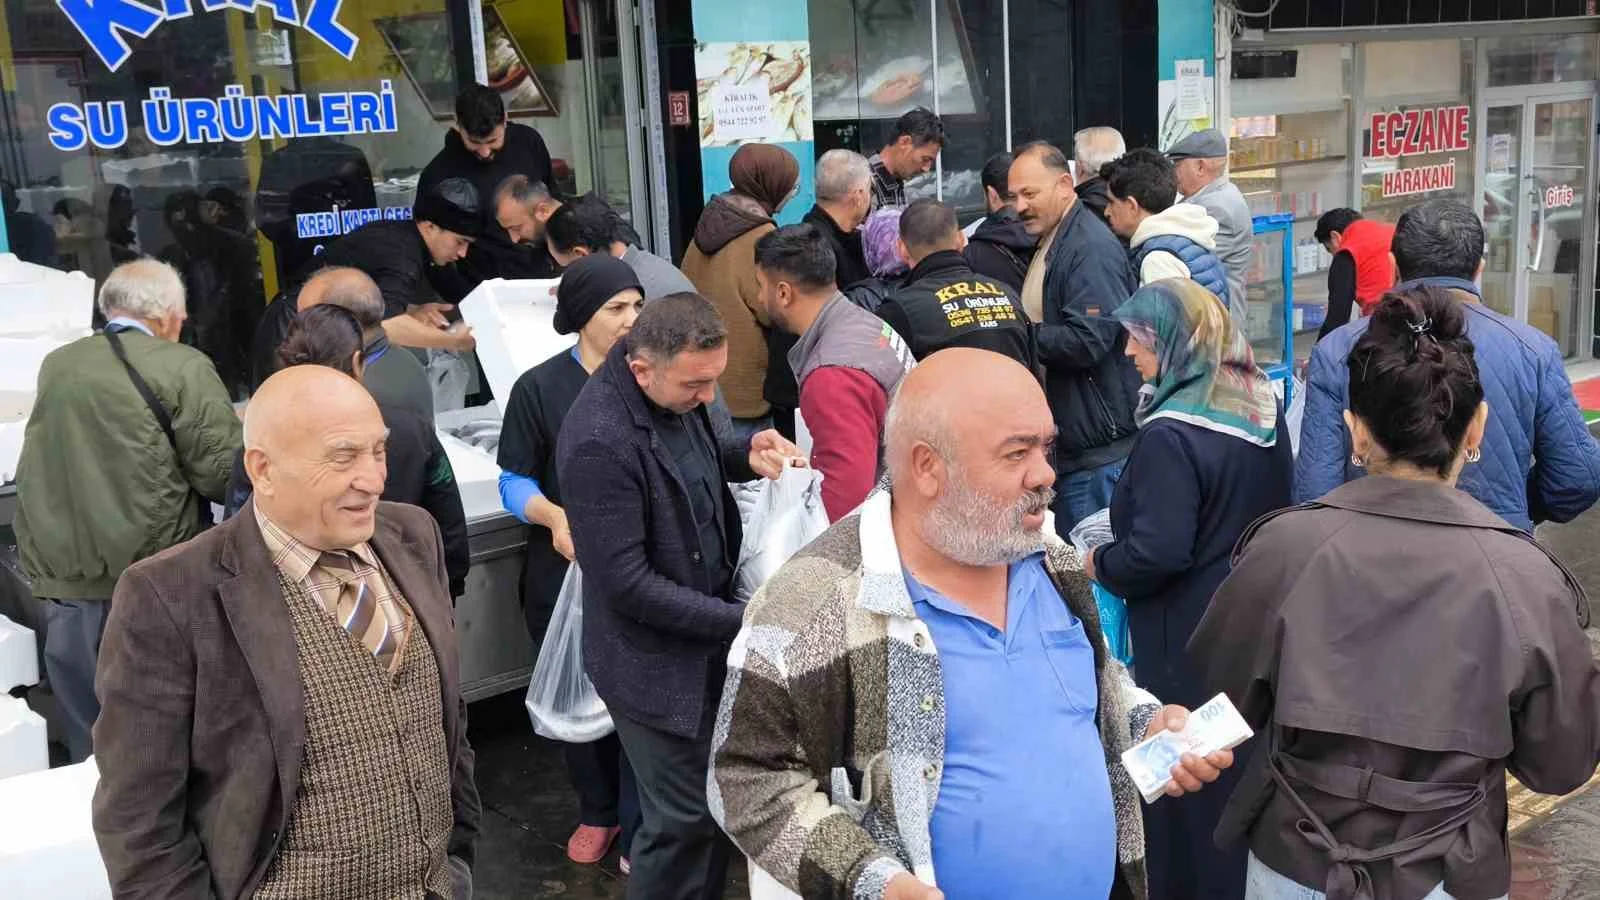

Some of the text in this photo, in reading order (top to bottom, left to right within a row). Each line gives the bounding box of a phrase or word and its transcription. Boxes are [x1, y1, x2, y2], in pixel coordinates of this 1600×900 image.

[47, 80, 398, 151] SU ÜRÜNLERİ
[672, 102, 683, 116] 12
[1371, 105, 1470, 158] ECZANE
[1382, 158, 1456, 198] HARAKANİ
[1545, 186, 1575, 209] Giriş
[296, 204, 341, 238] KREDİ
[341, 208, 383, 235] KARTI
[935, 282, 1004, 303] KRAL
[942, 302, 959, 313] SU
